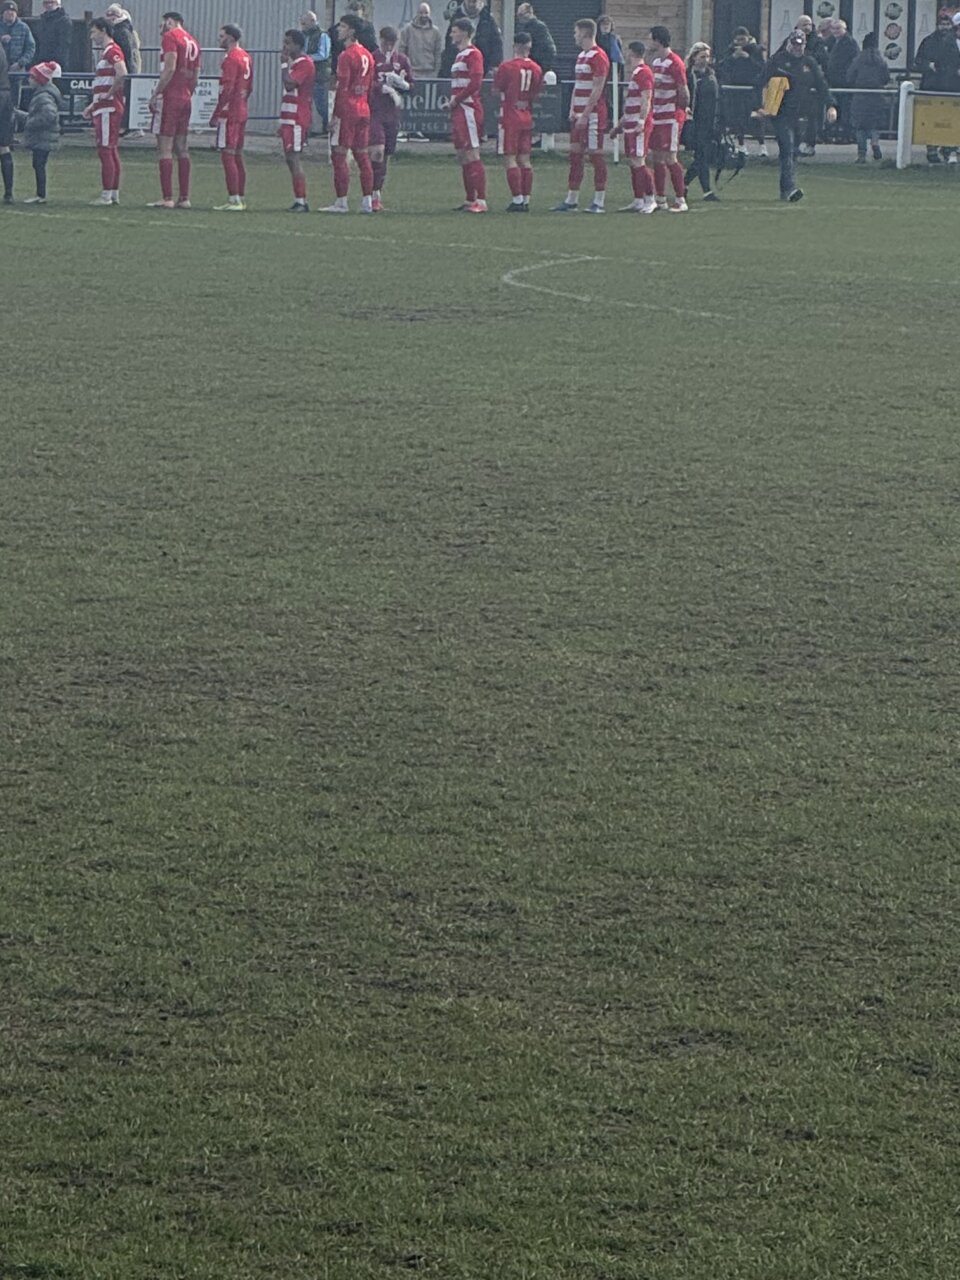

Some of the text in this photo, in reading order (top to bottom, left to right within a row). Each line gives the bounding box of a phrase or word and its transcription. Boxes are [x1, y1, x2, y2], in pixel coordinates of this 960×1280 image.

[184, 36, 198, 61] 10
[361, 55, 369, 77] 9
[520, 68, 532, 91] 11
